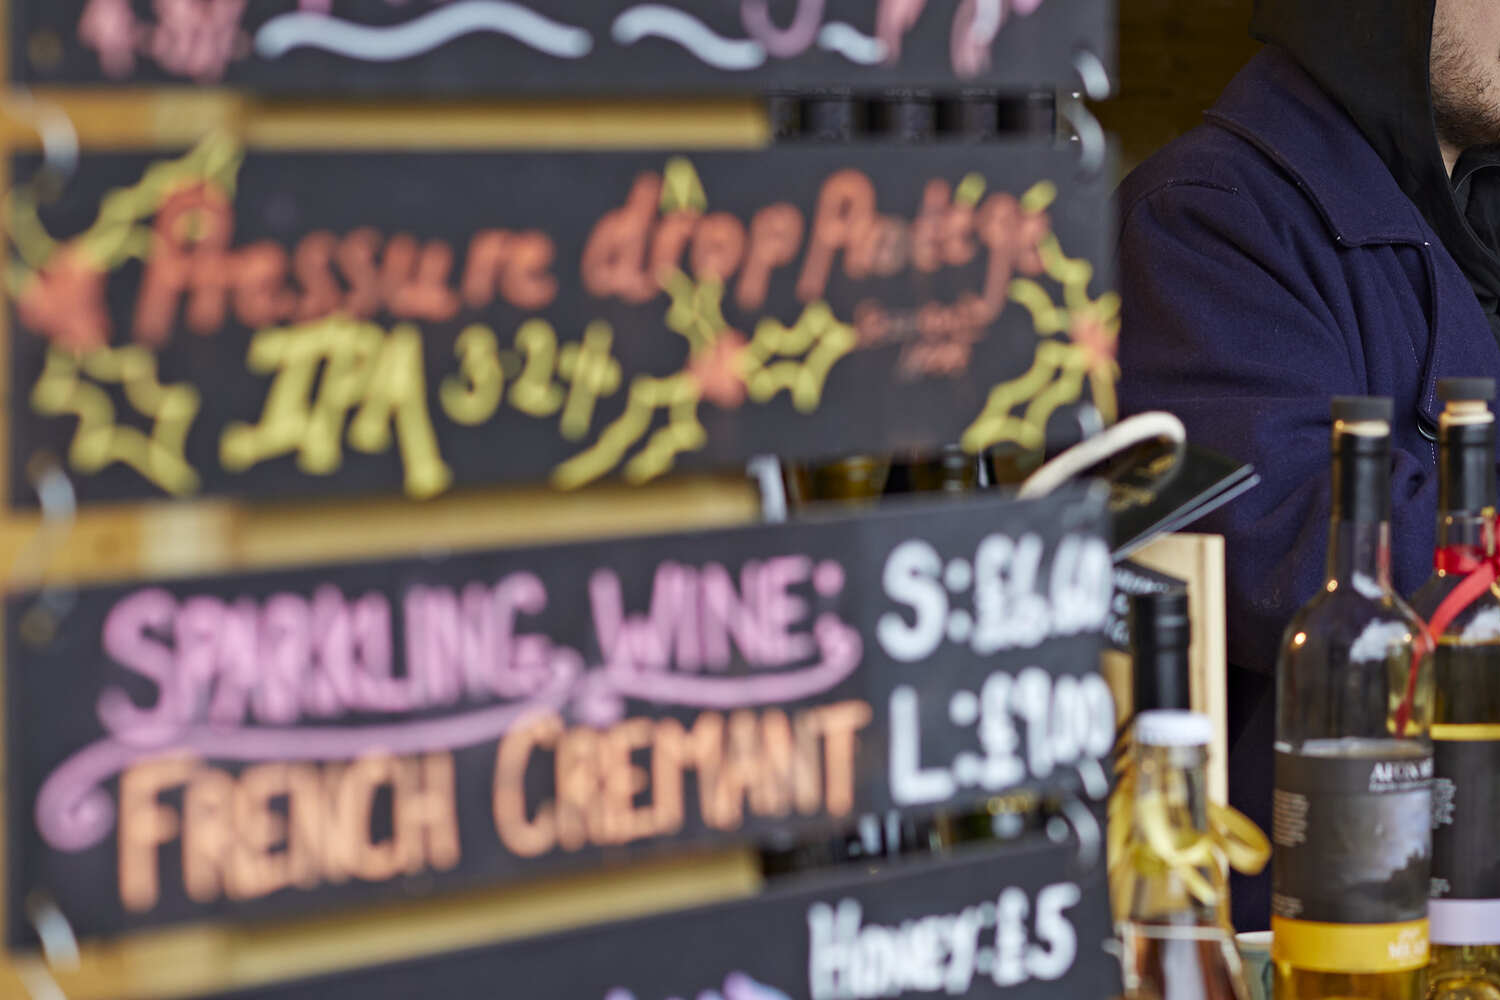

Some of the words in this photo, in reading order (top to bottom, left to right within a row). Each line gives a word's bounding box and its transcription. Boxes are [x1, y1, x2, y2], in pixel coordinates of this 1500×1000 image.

[131, 179, 559, 350] Pressure
[580, 169, 804, 310] drop
[98, 571, 552, 747] SPARKLING
[118, 749, 462, 910] FRENCH
[495, 700, 871, 858] CREMANT
